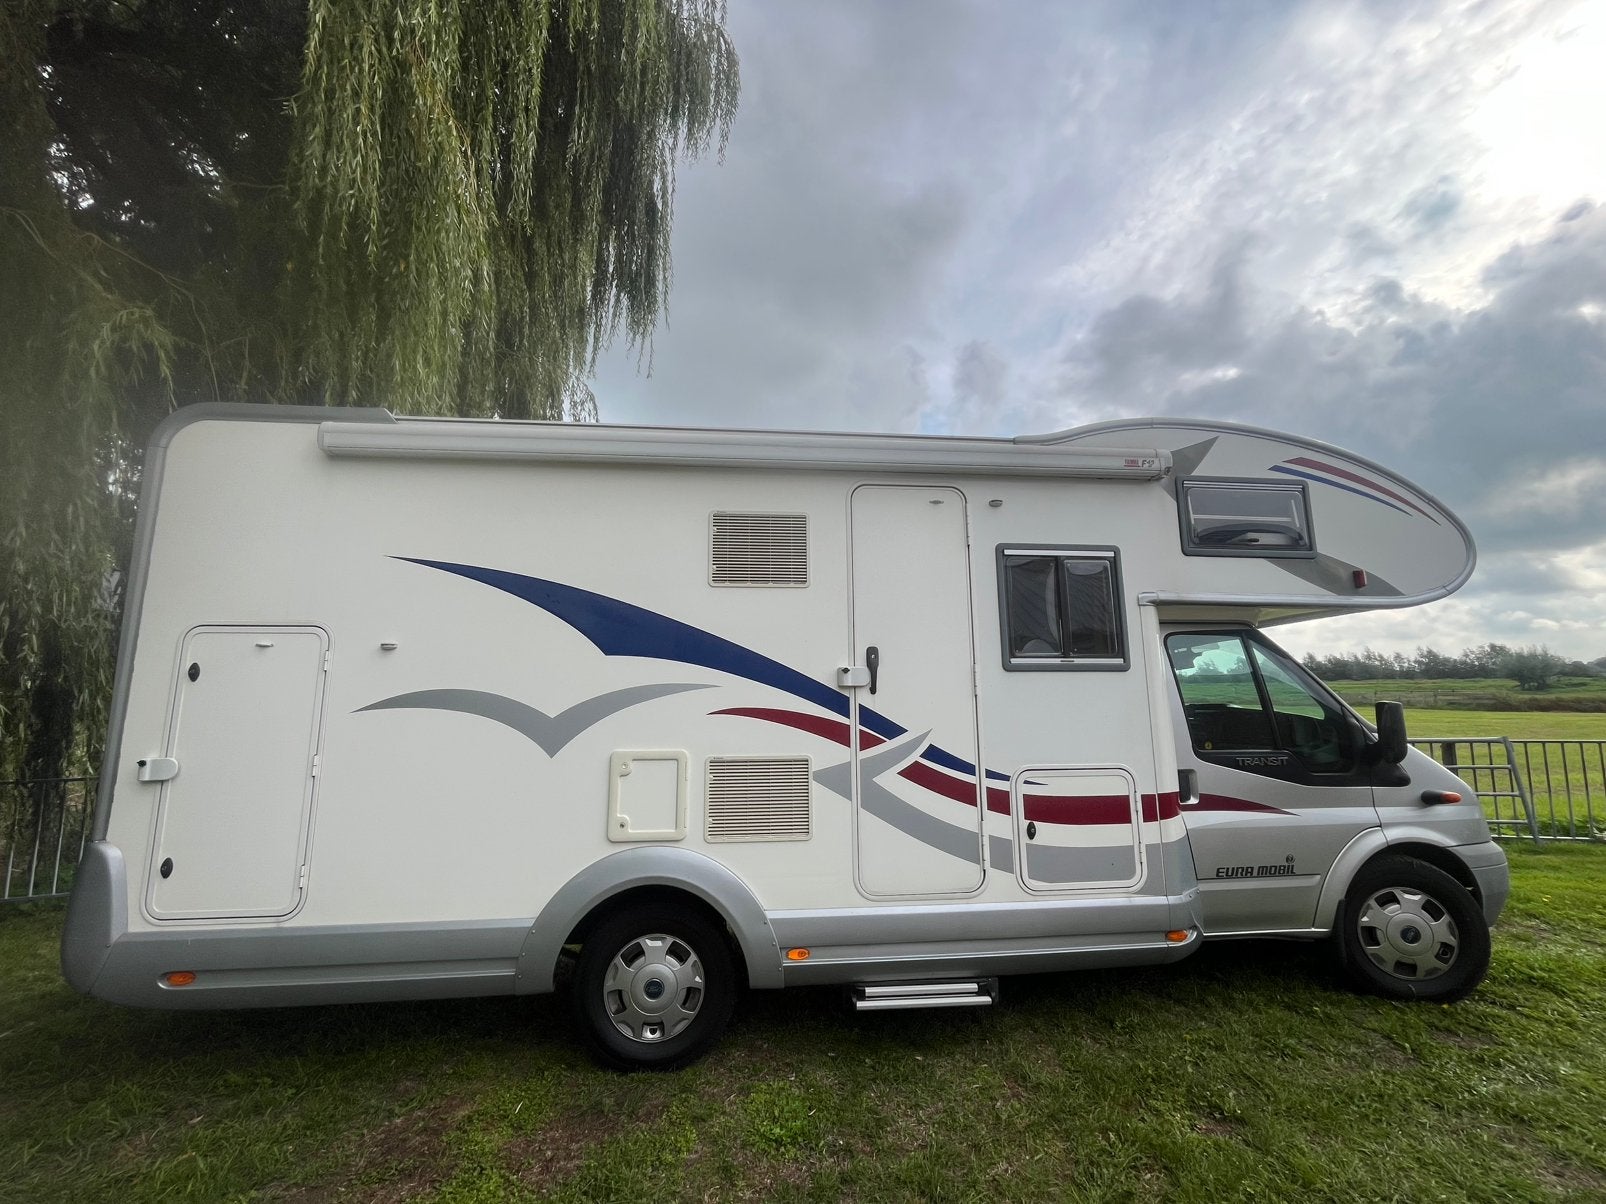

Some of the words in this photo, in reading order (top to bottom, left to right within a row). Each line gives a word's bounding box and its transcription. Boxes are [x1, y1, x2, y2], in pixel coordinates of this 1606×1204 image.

[1236, 756, 1288, 766] TRANSIT
[1216, 866, 1254, 878] EURA
[1257, 864, 1296, 876] MOBIL
